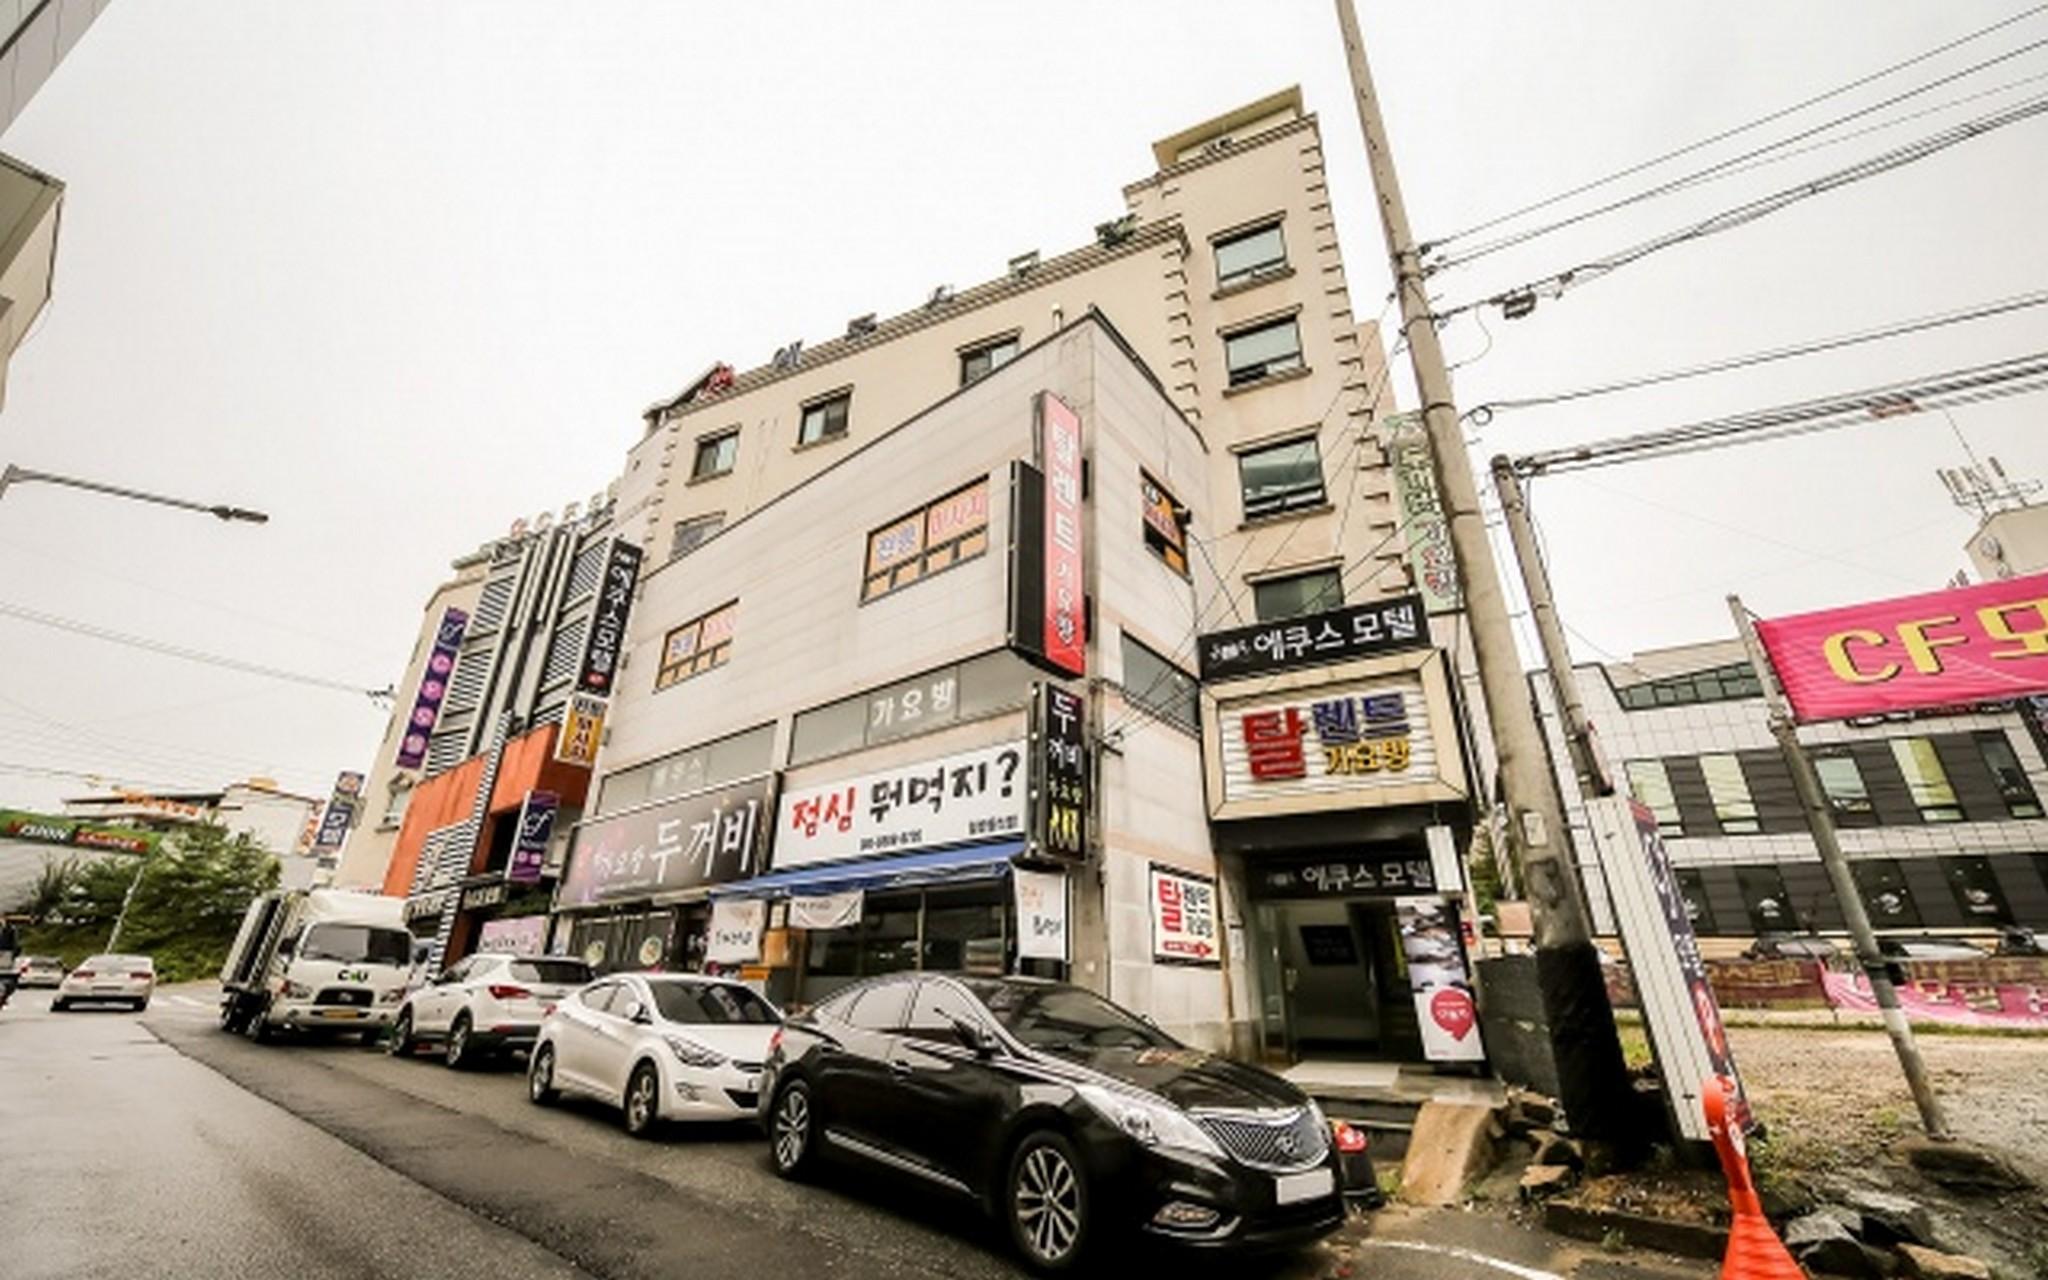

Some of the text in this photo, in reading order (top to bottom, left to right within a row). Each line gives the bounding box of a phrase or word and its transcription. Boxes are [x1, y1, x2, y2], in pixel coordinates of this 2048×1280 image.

[1253, 621, 1346, 660] 에쿠스
[1352, 604, 1418, 644] 모텔
[870, 678, 956, 728] 가요방
[1324, 736, 1411, 776] 가요방
[792, 750, 1021, 838] 점심 뭐먹지?
[649, 799, 758, 885] 두꺼비
[1301, 864, 1377, 891] 에쿠스
[1381, 860, 1433, 888] 모텔
